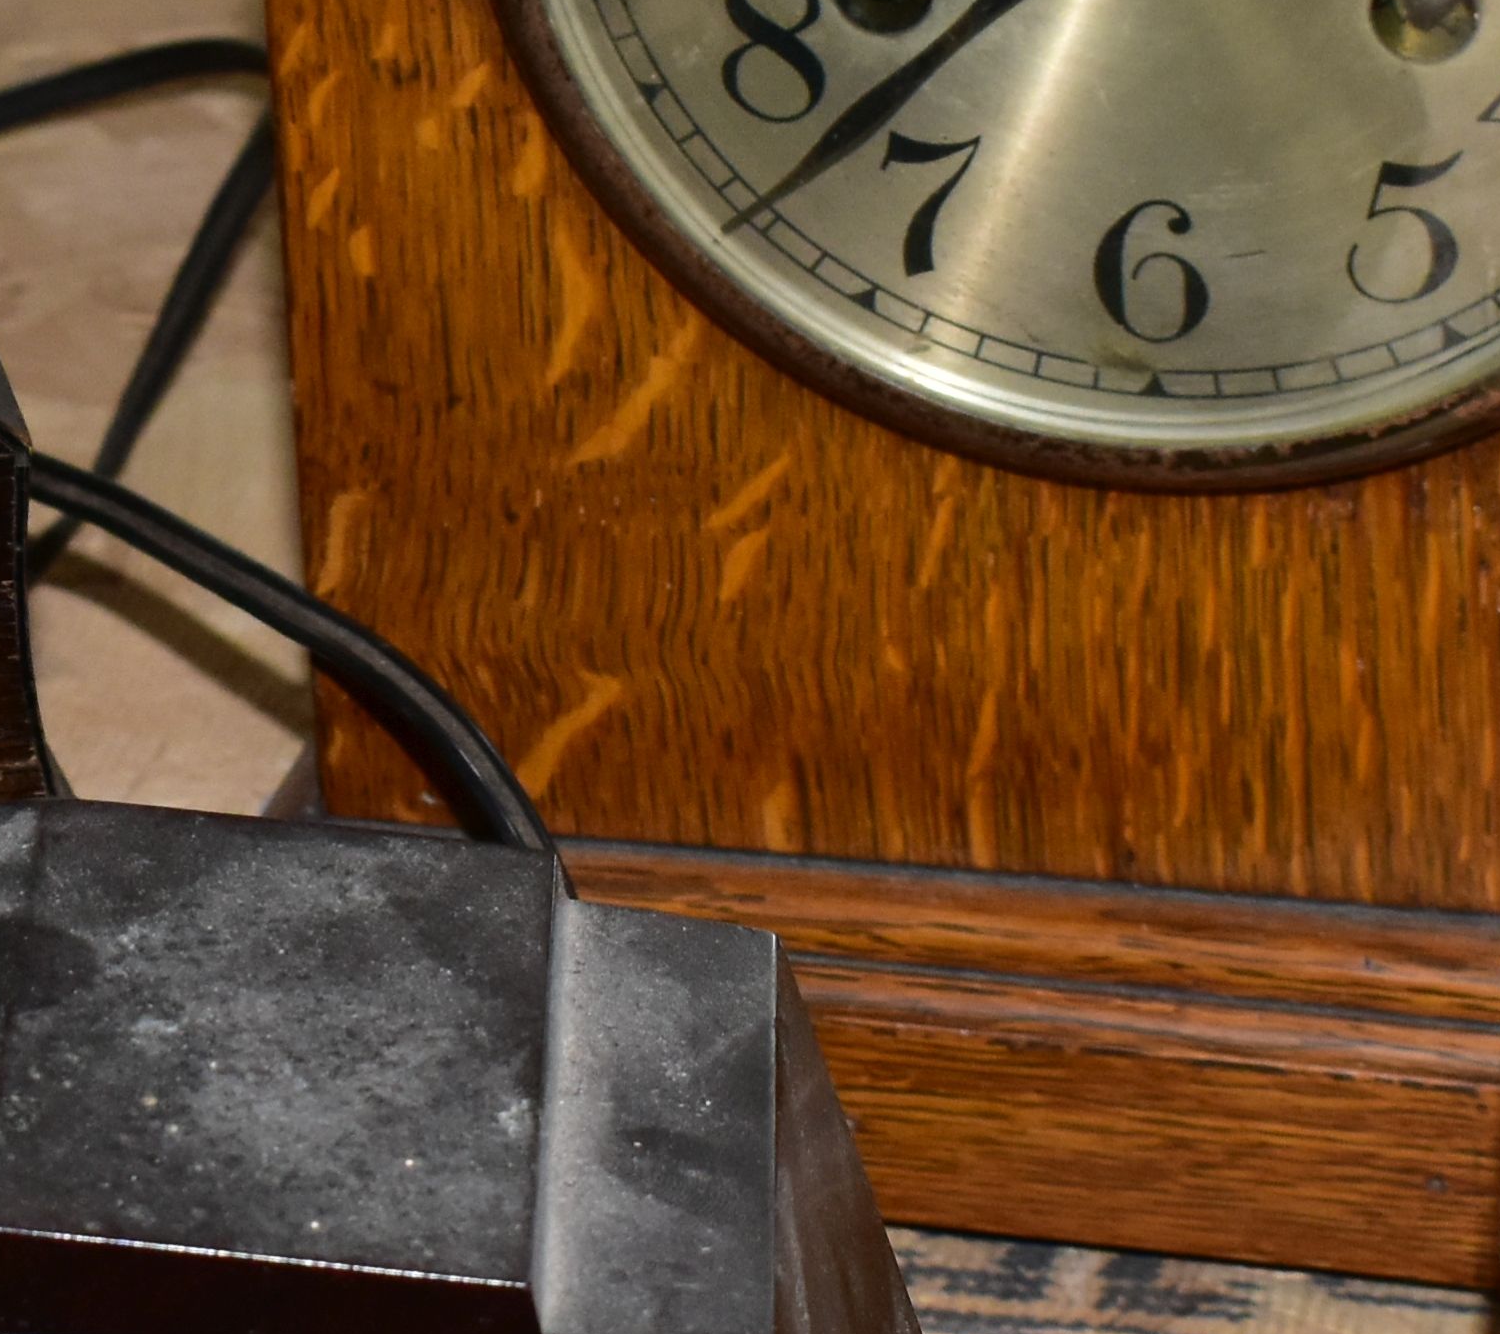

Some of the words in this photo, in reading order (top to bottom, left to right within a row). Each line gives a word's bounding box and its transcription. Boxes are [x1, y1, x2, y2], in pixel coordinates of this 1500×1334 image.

[879, 133, 983, 278] 7
[1093, 197, 1211, 343] 6
[1345, 148, 1463, 305] 5
